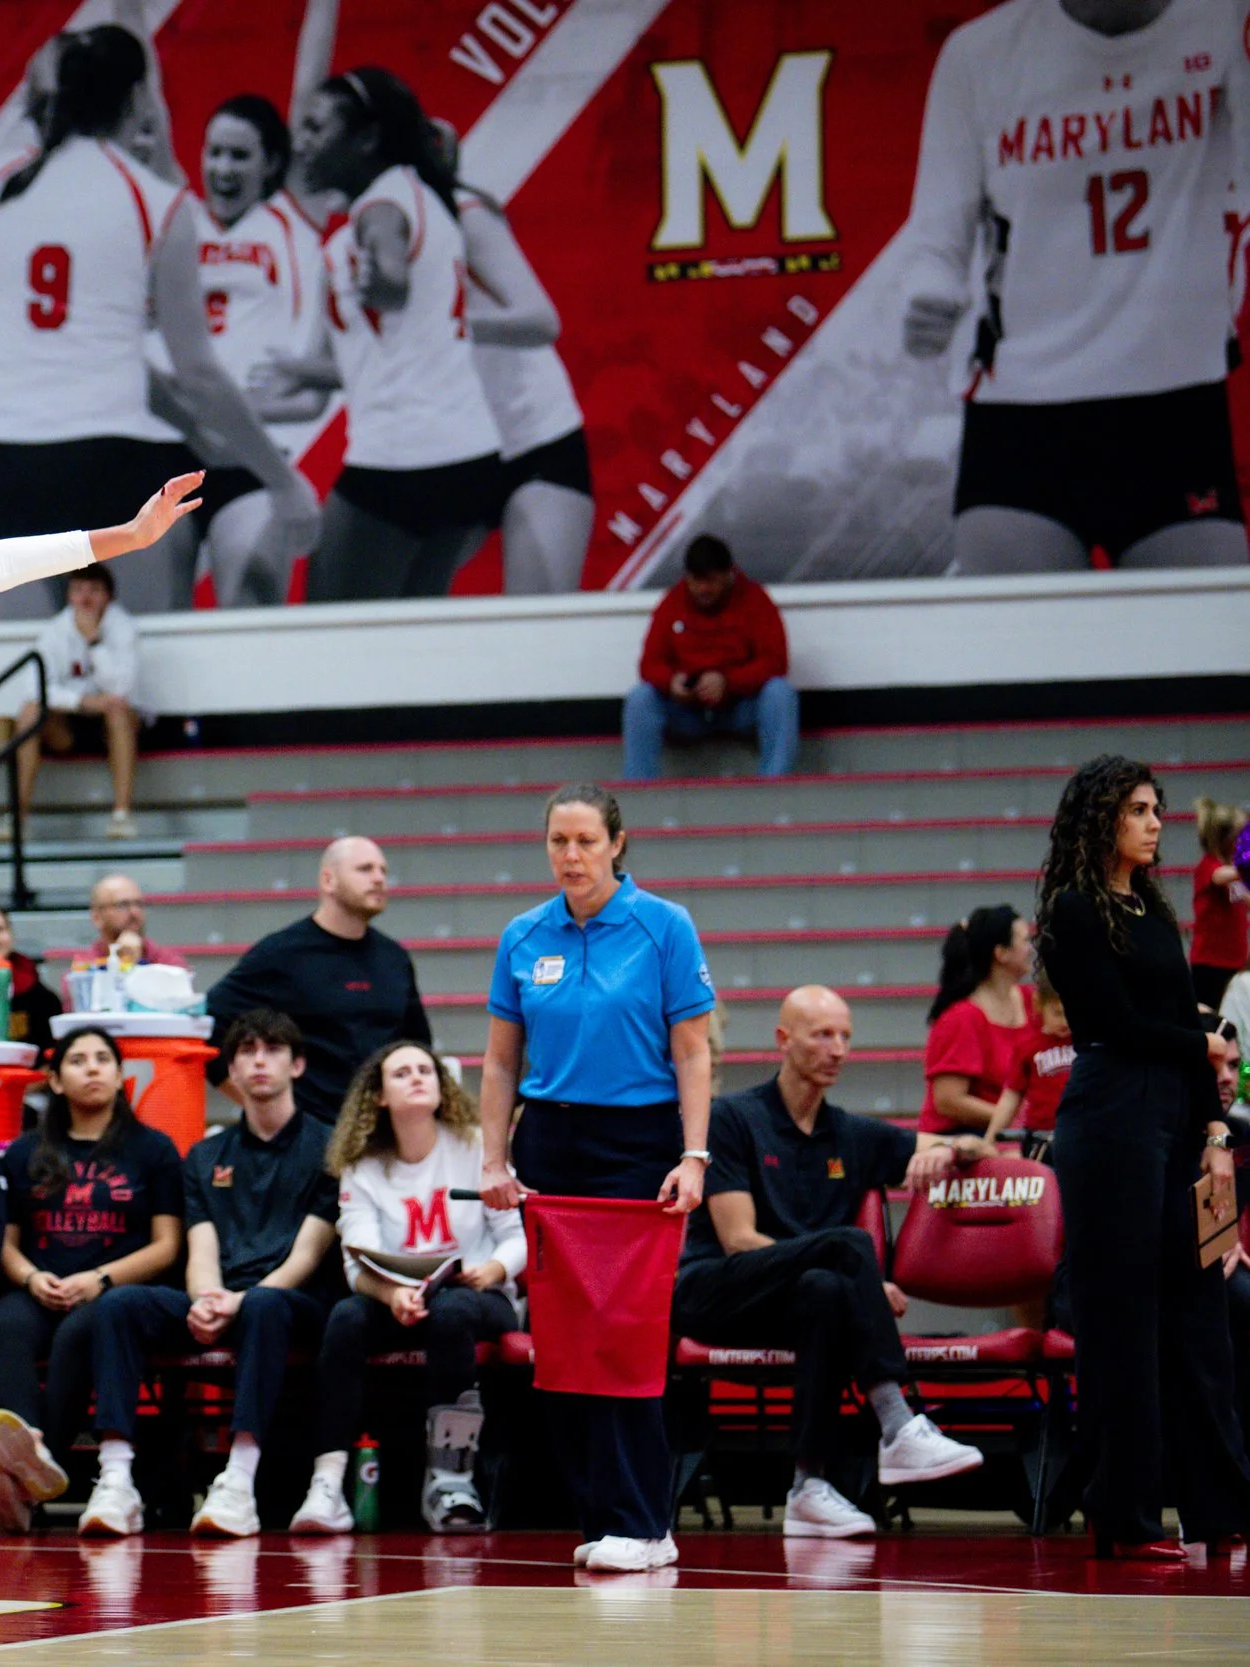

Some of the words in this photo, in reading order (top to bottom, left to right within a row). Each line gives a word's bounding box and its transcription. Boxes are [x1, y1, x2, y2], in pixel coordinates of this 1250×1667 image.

[646, 47, 839, 251] M
[1086, 167, 1150, 257] 12
[28, 243, 73, 329] 9
[606, 294, 820, 546] MARYLAND
[400, 1184, 460, 1254] M
[928, 1175, 1046, 1203] MARYLAND
